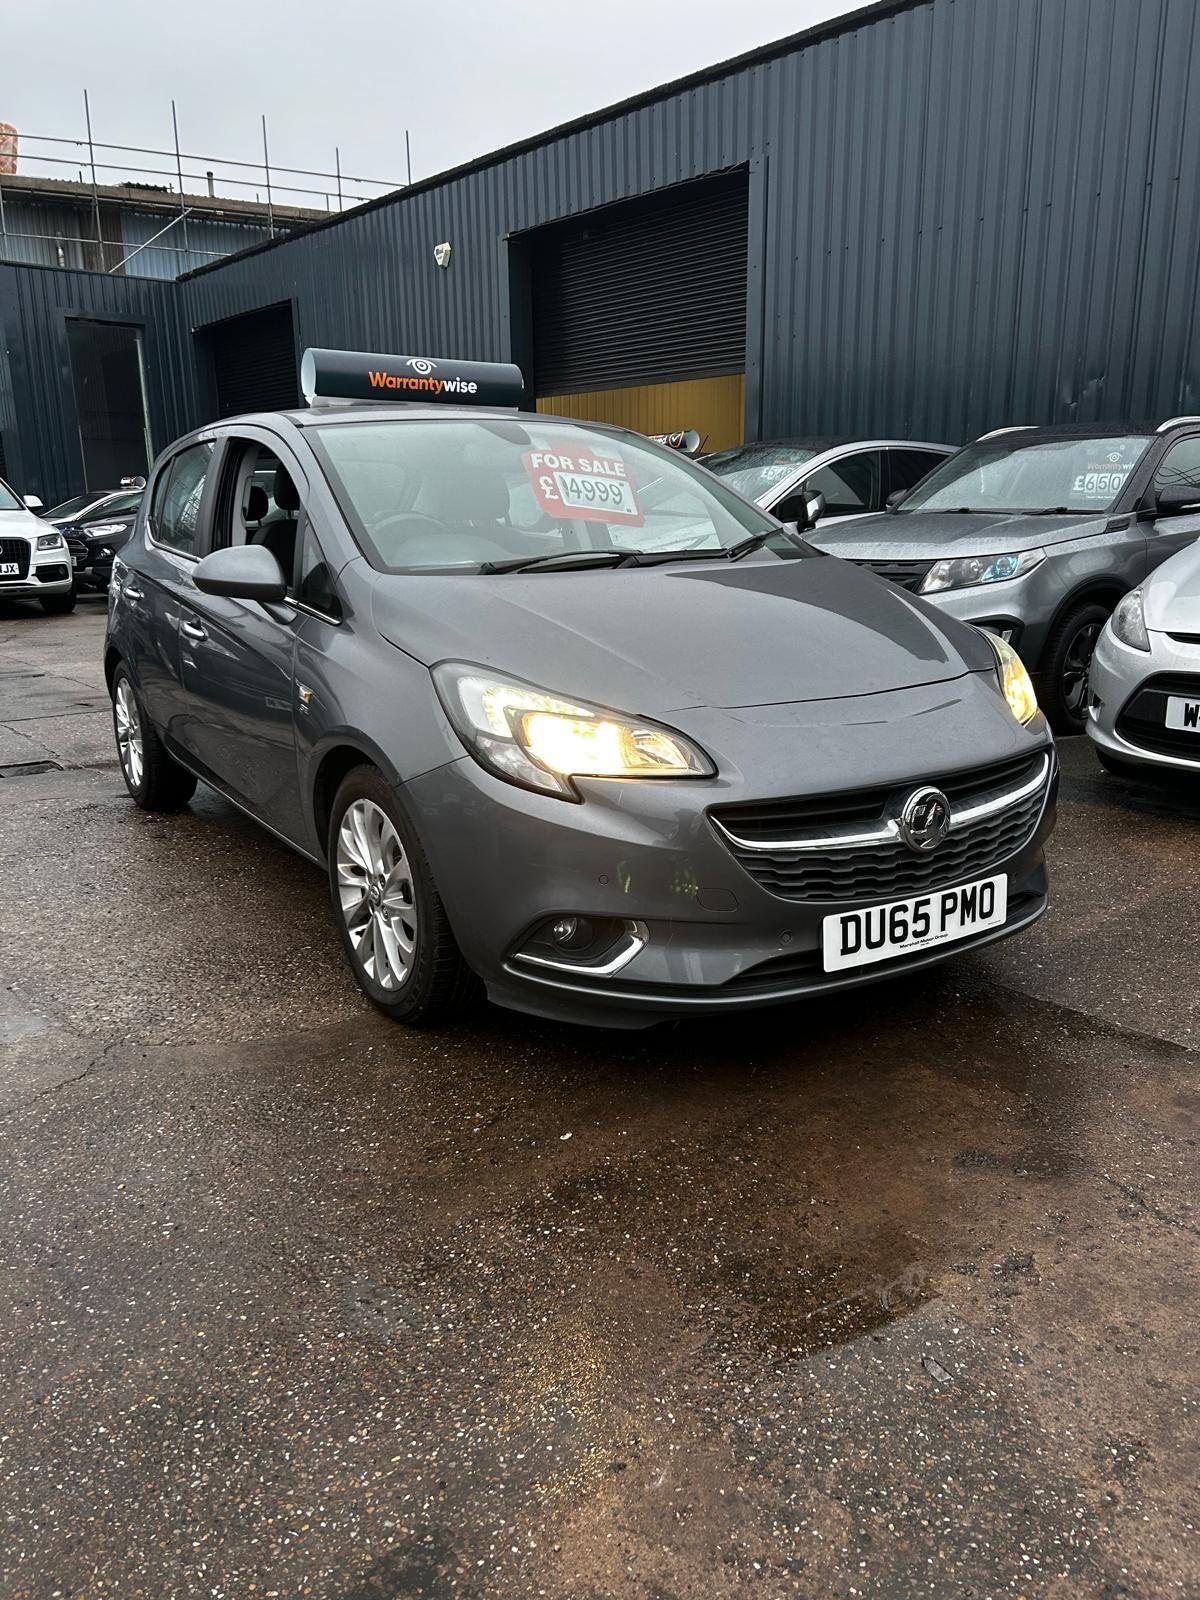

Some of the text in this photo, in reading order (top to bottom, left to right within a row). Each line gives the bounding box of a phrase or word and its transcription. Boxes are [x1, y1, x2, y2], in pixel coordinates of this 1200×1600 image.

[368, 371, 478, 395] Warrantywise
[530, 453, 626, 477] FOR SALE
[1073, 475, 1122, 491] £650
[1184, 702, 1200, 728] W
[840, 881, 995, 956] DU65 PMO
